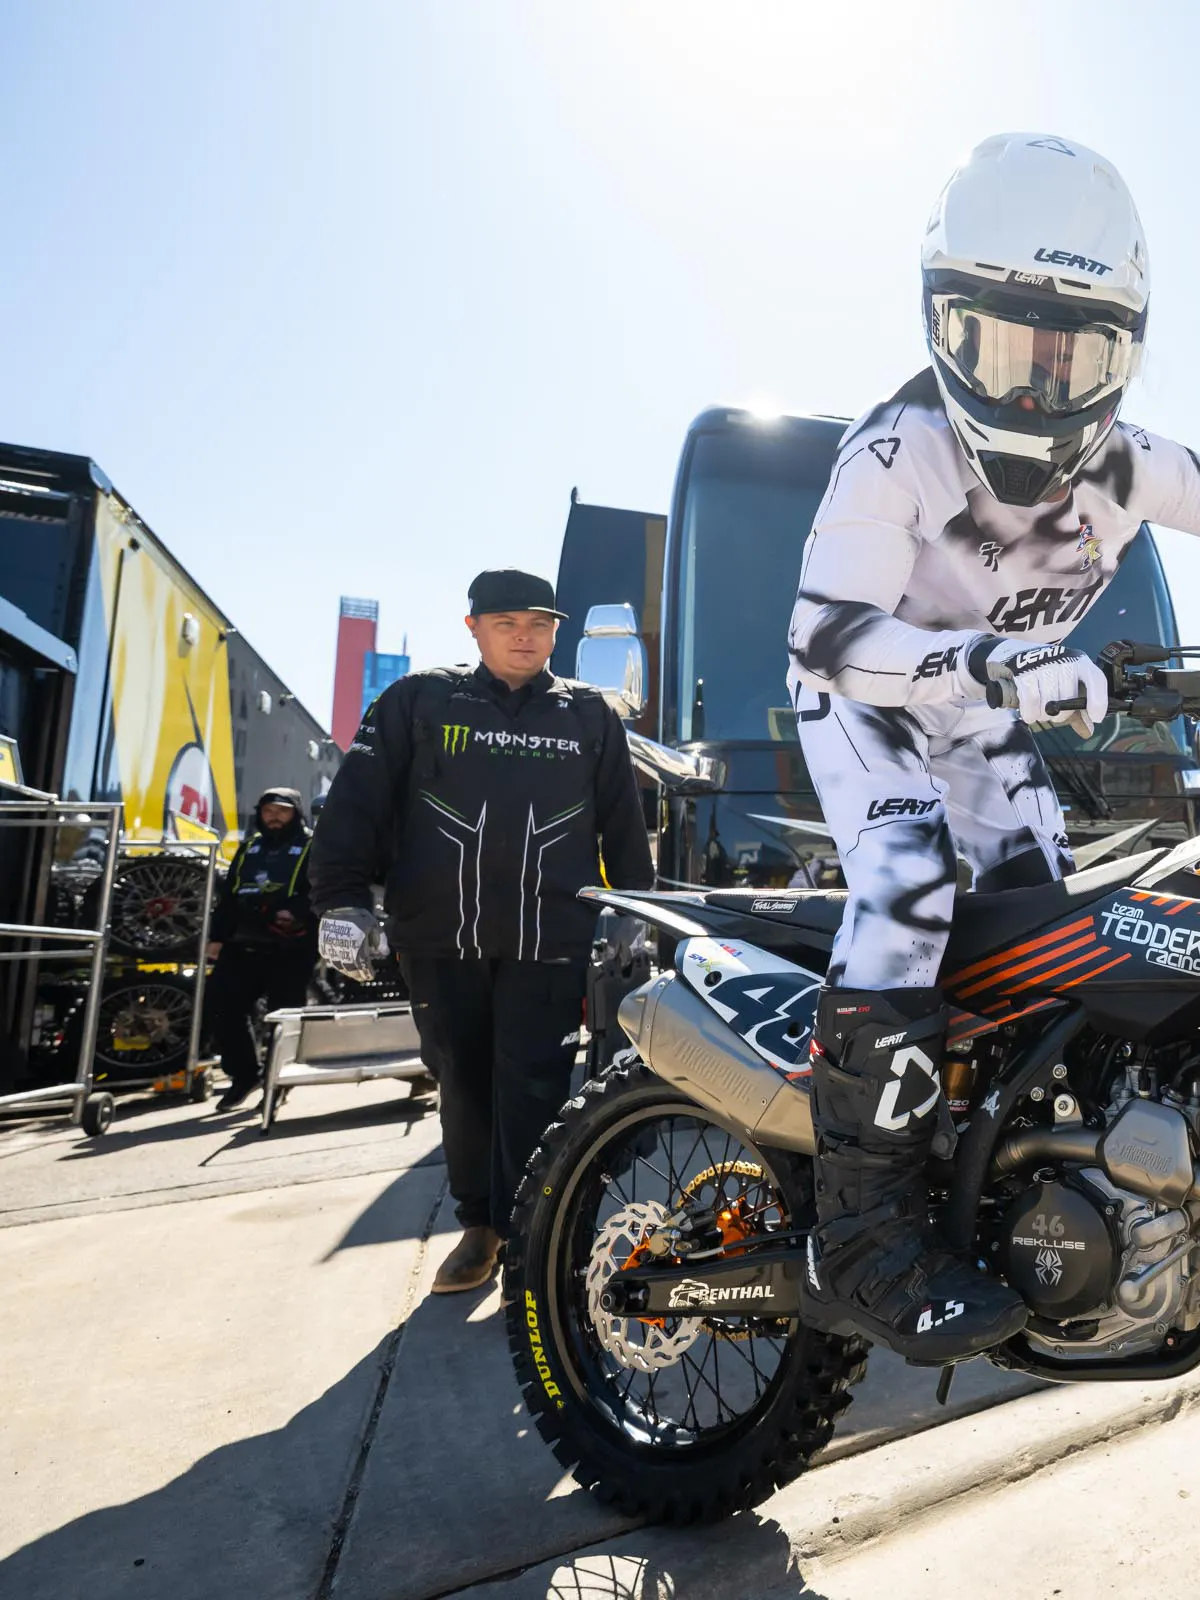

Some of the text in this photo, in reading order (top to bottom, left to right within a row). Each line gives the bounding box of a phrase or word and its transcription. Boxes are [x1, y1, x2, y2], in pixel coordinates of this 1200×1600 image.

[1033, 248, 1113, 276] LEATT
[1014, 271, 1049, 286] LEATT
[932, 302, 941, 348] LEATT
[985, 575, 1104, 633] LEATT
[1016, 645, 1066, 669] LEATT
[474, 730, 582, 754] MONSTER
[491, 748, 567, 760] ENERGY
[1111, 901, 1145, 919] team
[874, 1031, 907, 1049] LEATT
[1031, 1214, 1065, 1237] 46
[1012, 1236, 1086, 1251] REKLUSE
[698, 1285, 775, 1300] RENTHAL
[916, 1300, 965, 1334] 4.5
[525, 1290, 562, 1399] DUNLOP
